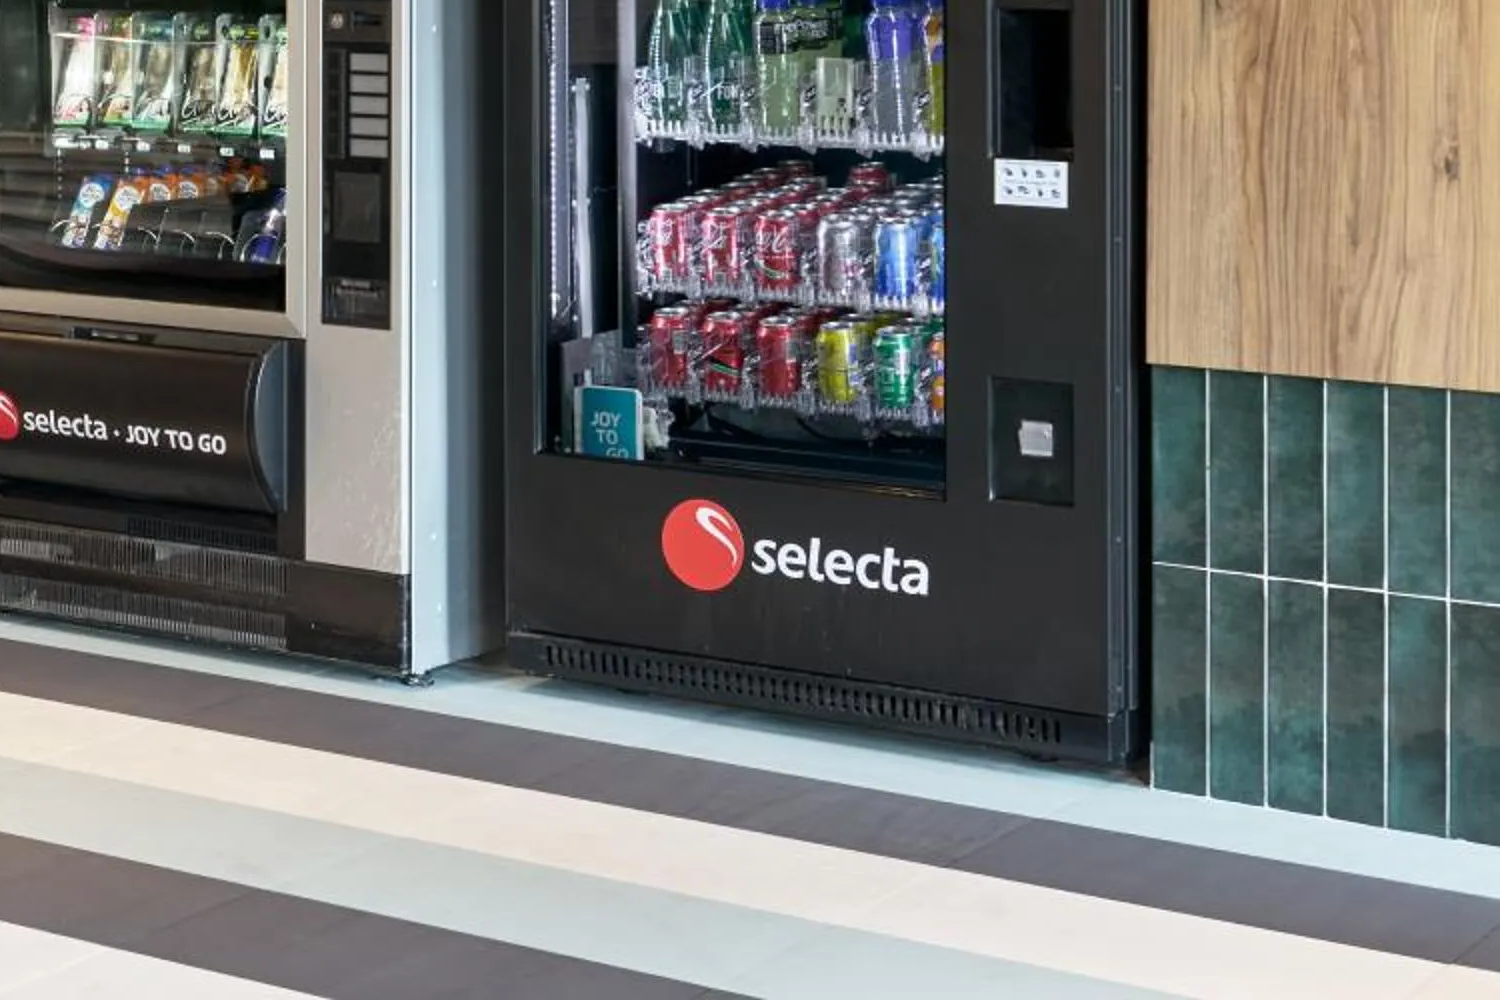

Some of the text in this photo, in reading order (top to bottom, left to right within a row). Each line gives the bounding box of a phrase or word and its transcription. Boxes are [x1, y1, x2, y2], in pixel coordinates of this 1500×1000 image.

[22, 408, 227, 455] selecta JOY TO GO
[591, 411, 621, 428] JOY
[595, 429, 618, 445] TO
[750, 536, 930, 597] selecta
